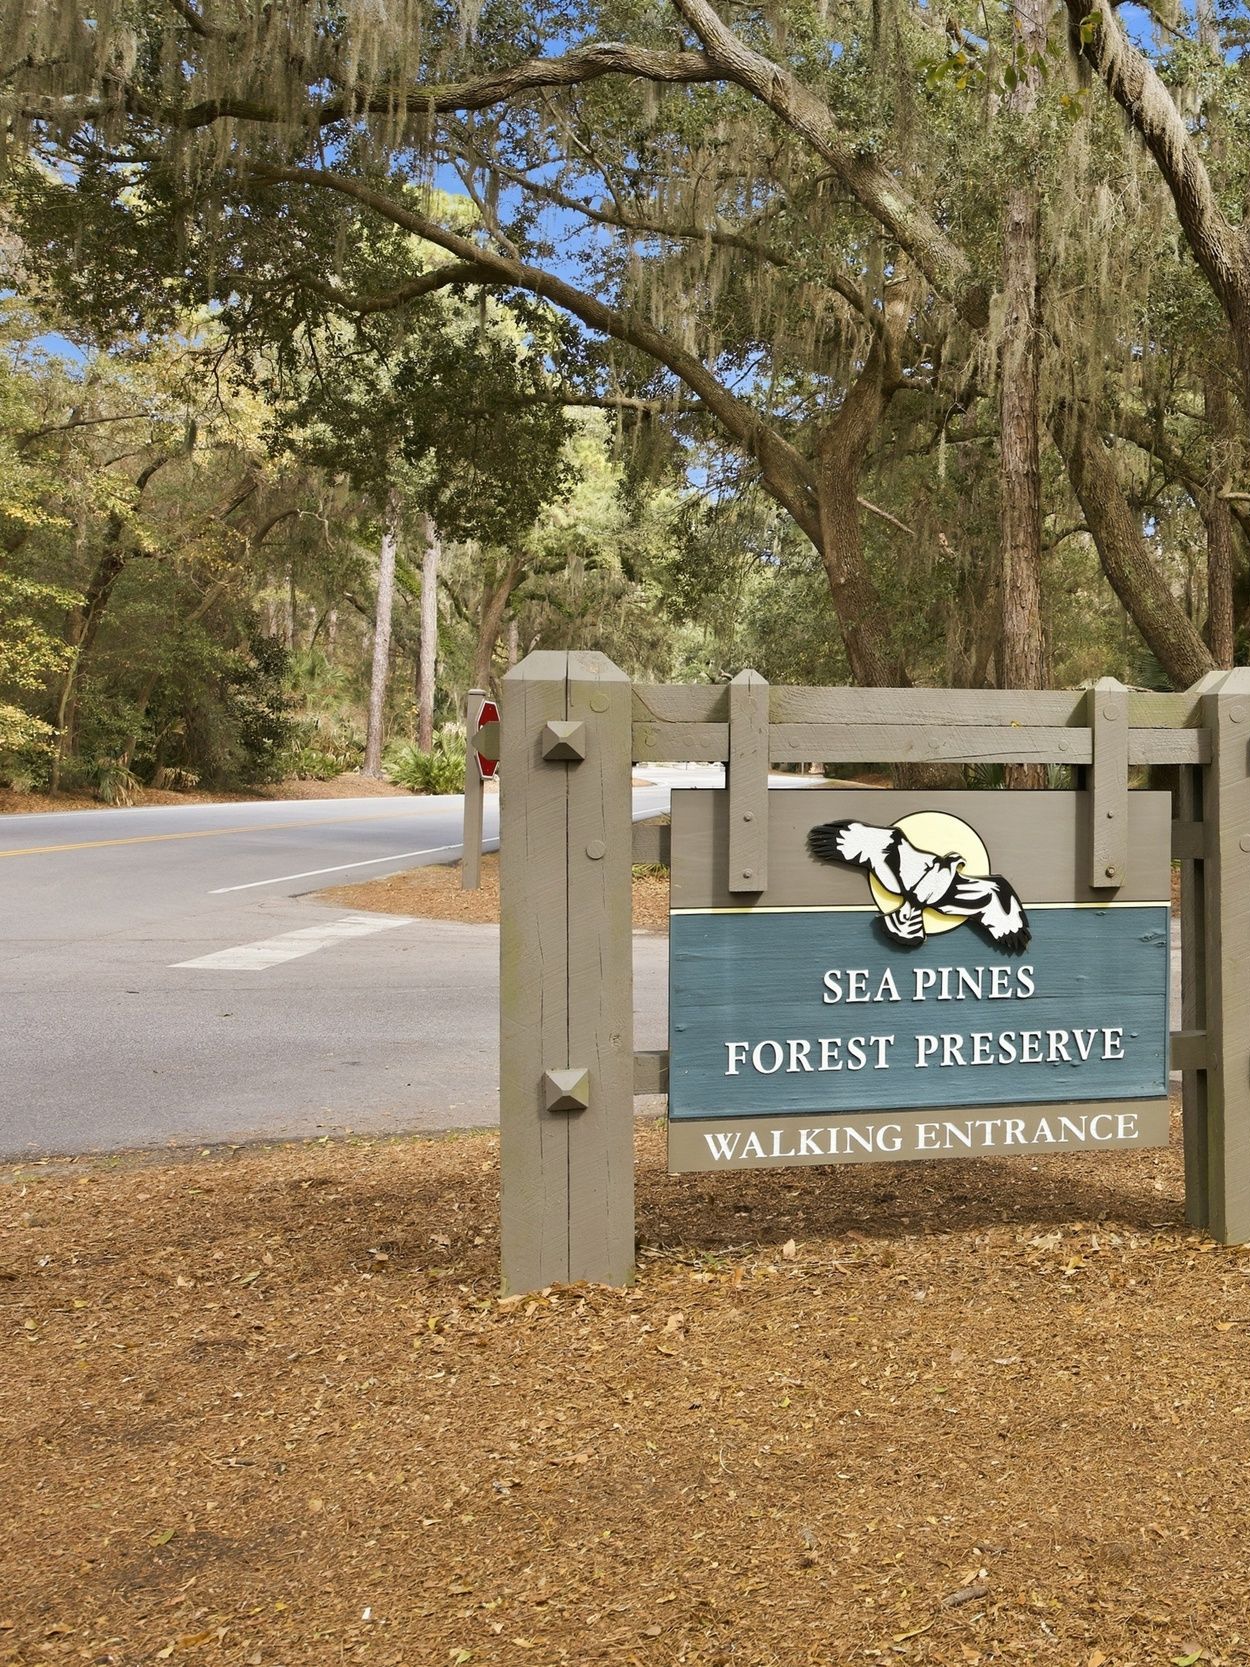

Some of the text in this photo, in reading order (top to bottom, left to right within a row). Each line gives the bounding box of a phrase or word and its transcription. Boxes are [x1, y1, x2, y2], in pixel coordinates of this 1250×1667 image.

[822, 965, 1036, 1004] SEA PINES
[724, 1027, 1126, 1076] FOREST PRESERVE
[704, 1113, 1139, 1161] WALKING ENTRANCE
